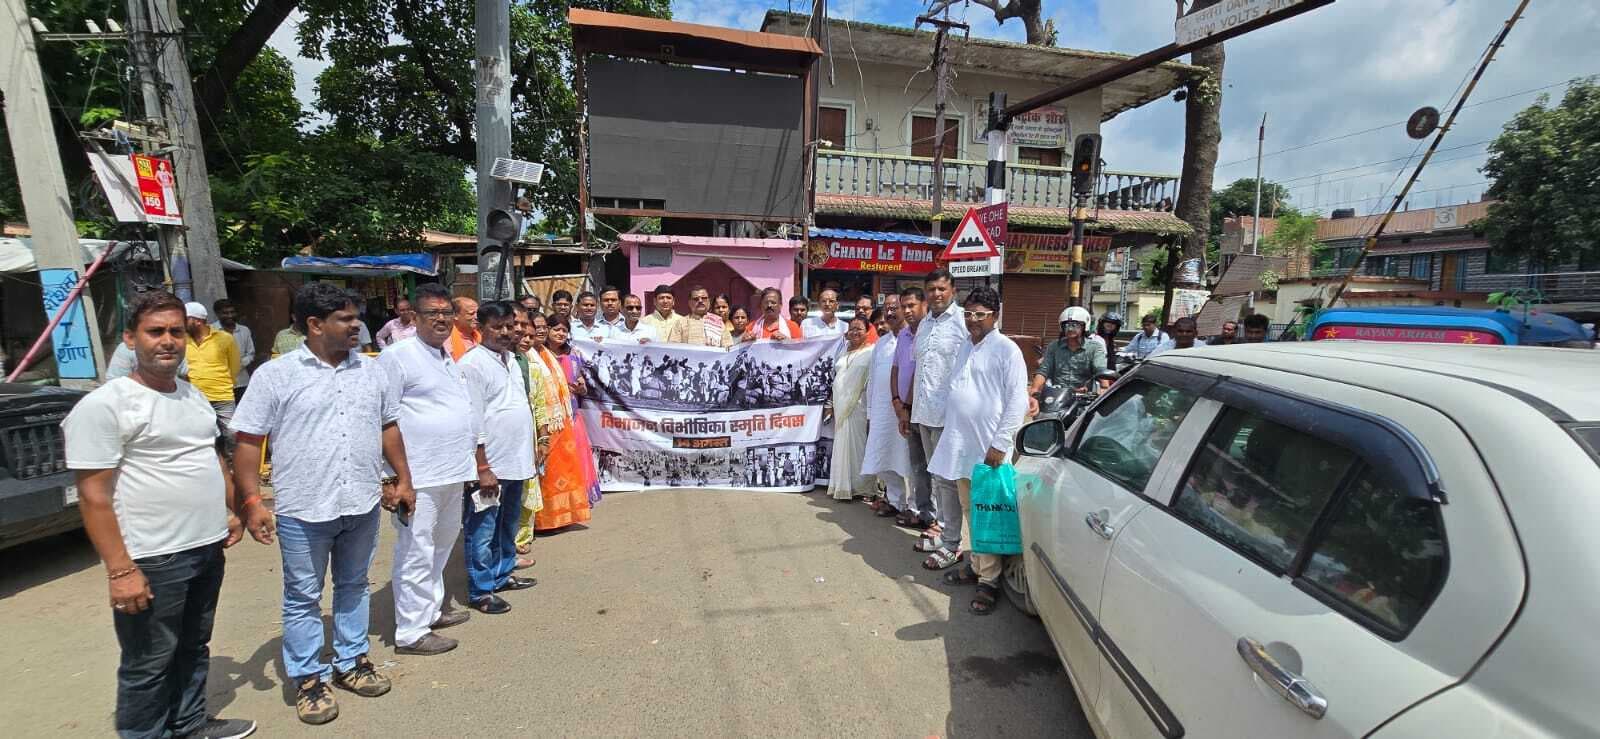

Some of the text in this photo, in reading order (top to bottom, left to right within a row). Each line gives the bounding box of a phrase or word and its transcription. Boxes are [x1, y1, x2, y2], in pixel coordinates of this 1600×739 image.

[1220, 6, 1260, 28] VOLTS
[951, 264, 989, 273] SPEED BREAKER
[601, 412, 806, 436] विभाजन विभीषिका स्मृति दिवस
